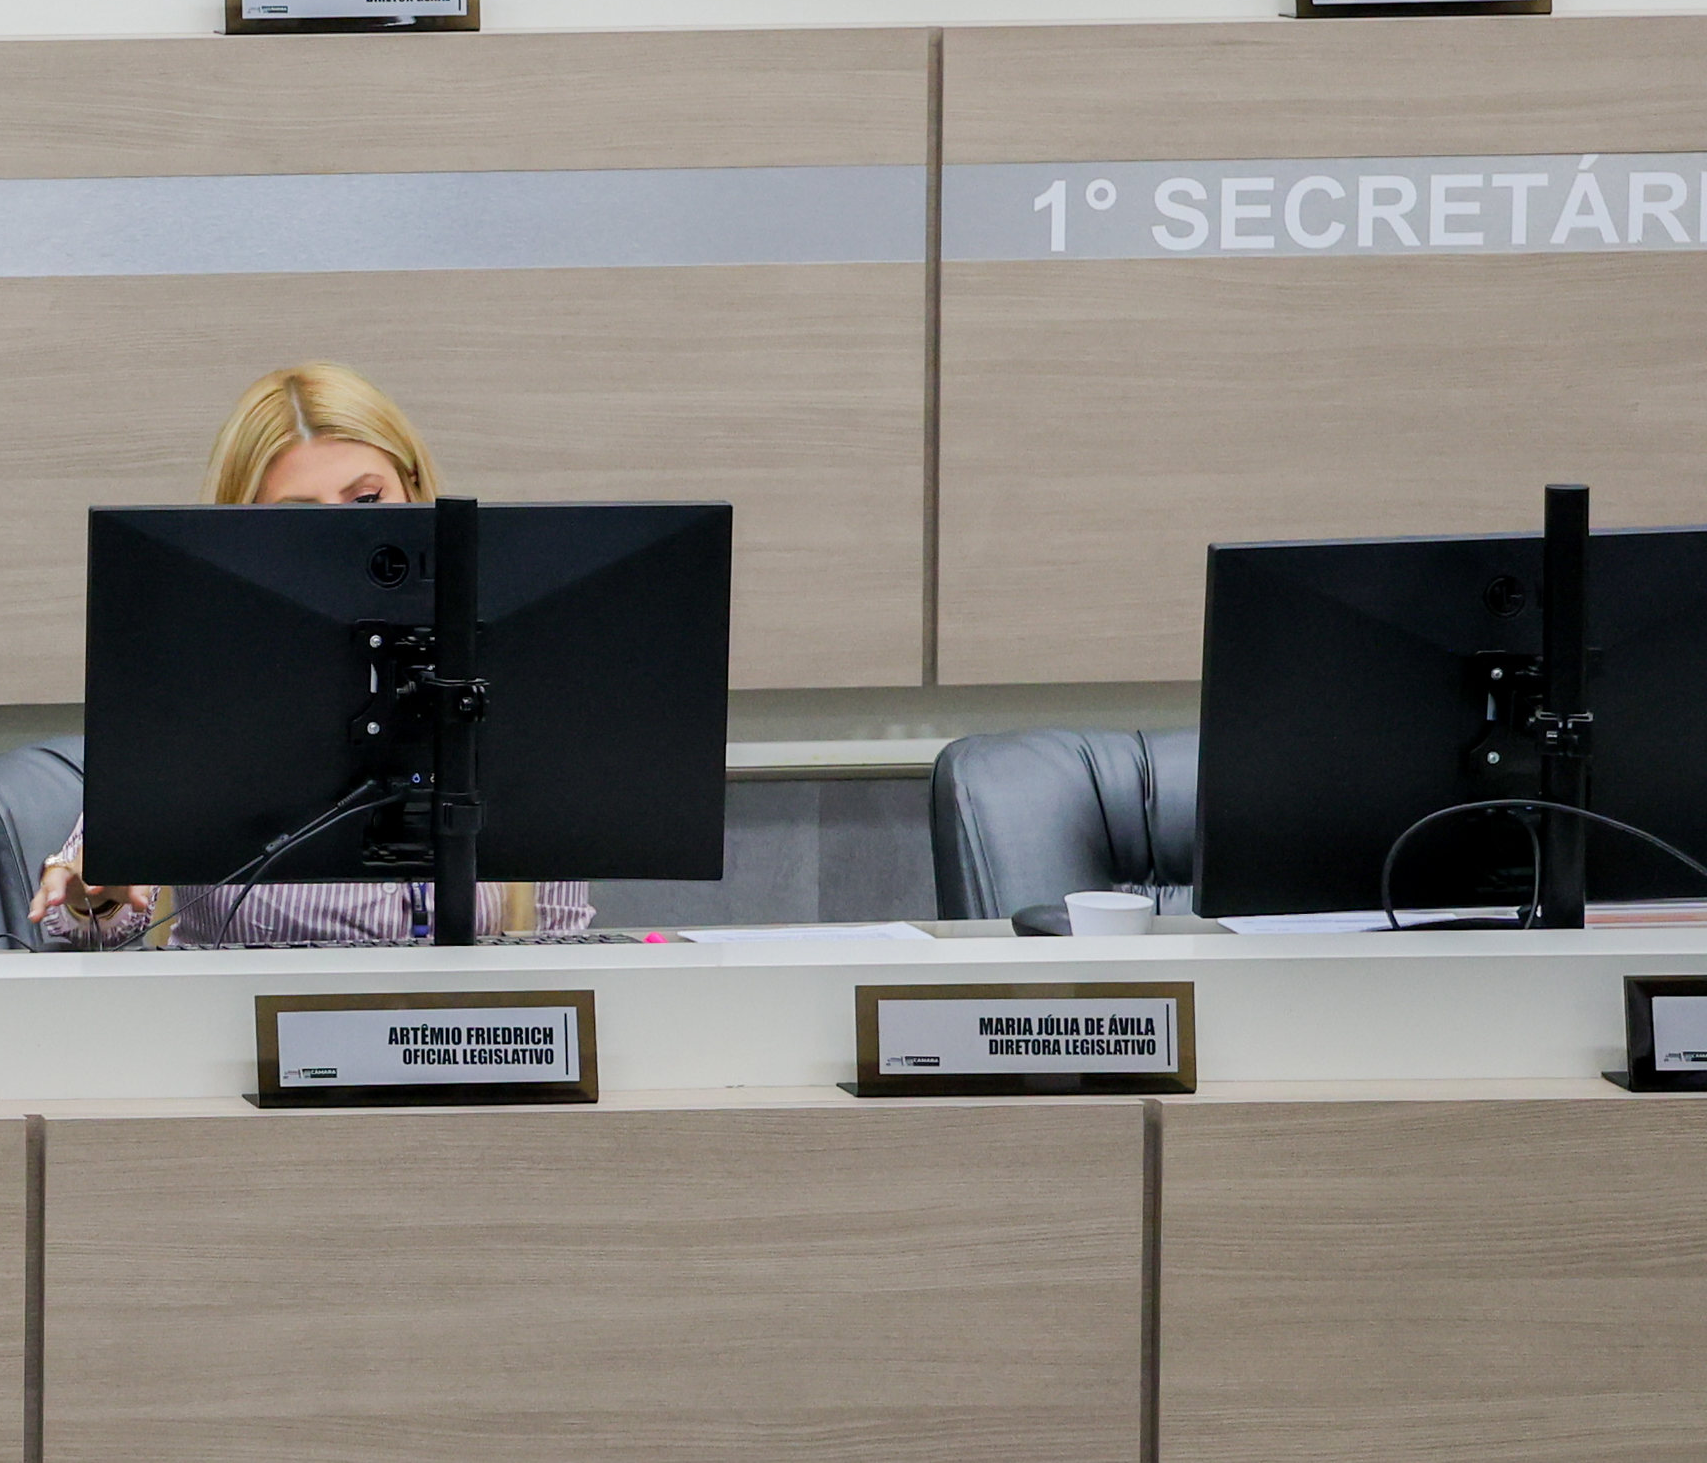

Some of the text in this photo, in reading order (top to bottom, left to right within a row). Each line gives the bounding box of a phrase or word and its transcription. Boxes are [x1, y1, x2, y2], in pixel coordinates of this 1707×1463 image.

[388, 1024, 554, 1046] ARTÊMIO FRIEDRICH
[979, 1014, 1155, 1036] MARIA JÚLIA DE ÁVILA
[402, 1047, 554, 1065] OFICIAL LEGISLATIVO
[988, 1038, 1156, 1055] DIRETORA LEGISLATIVO
